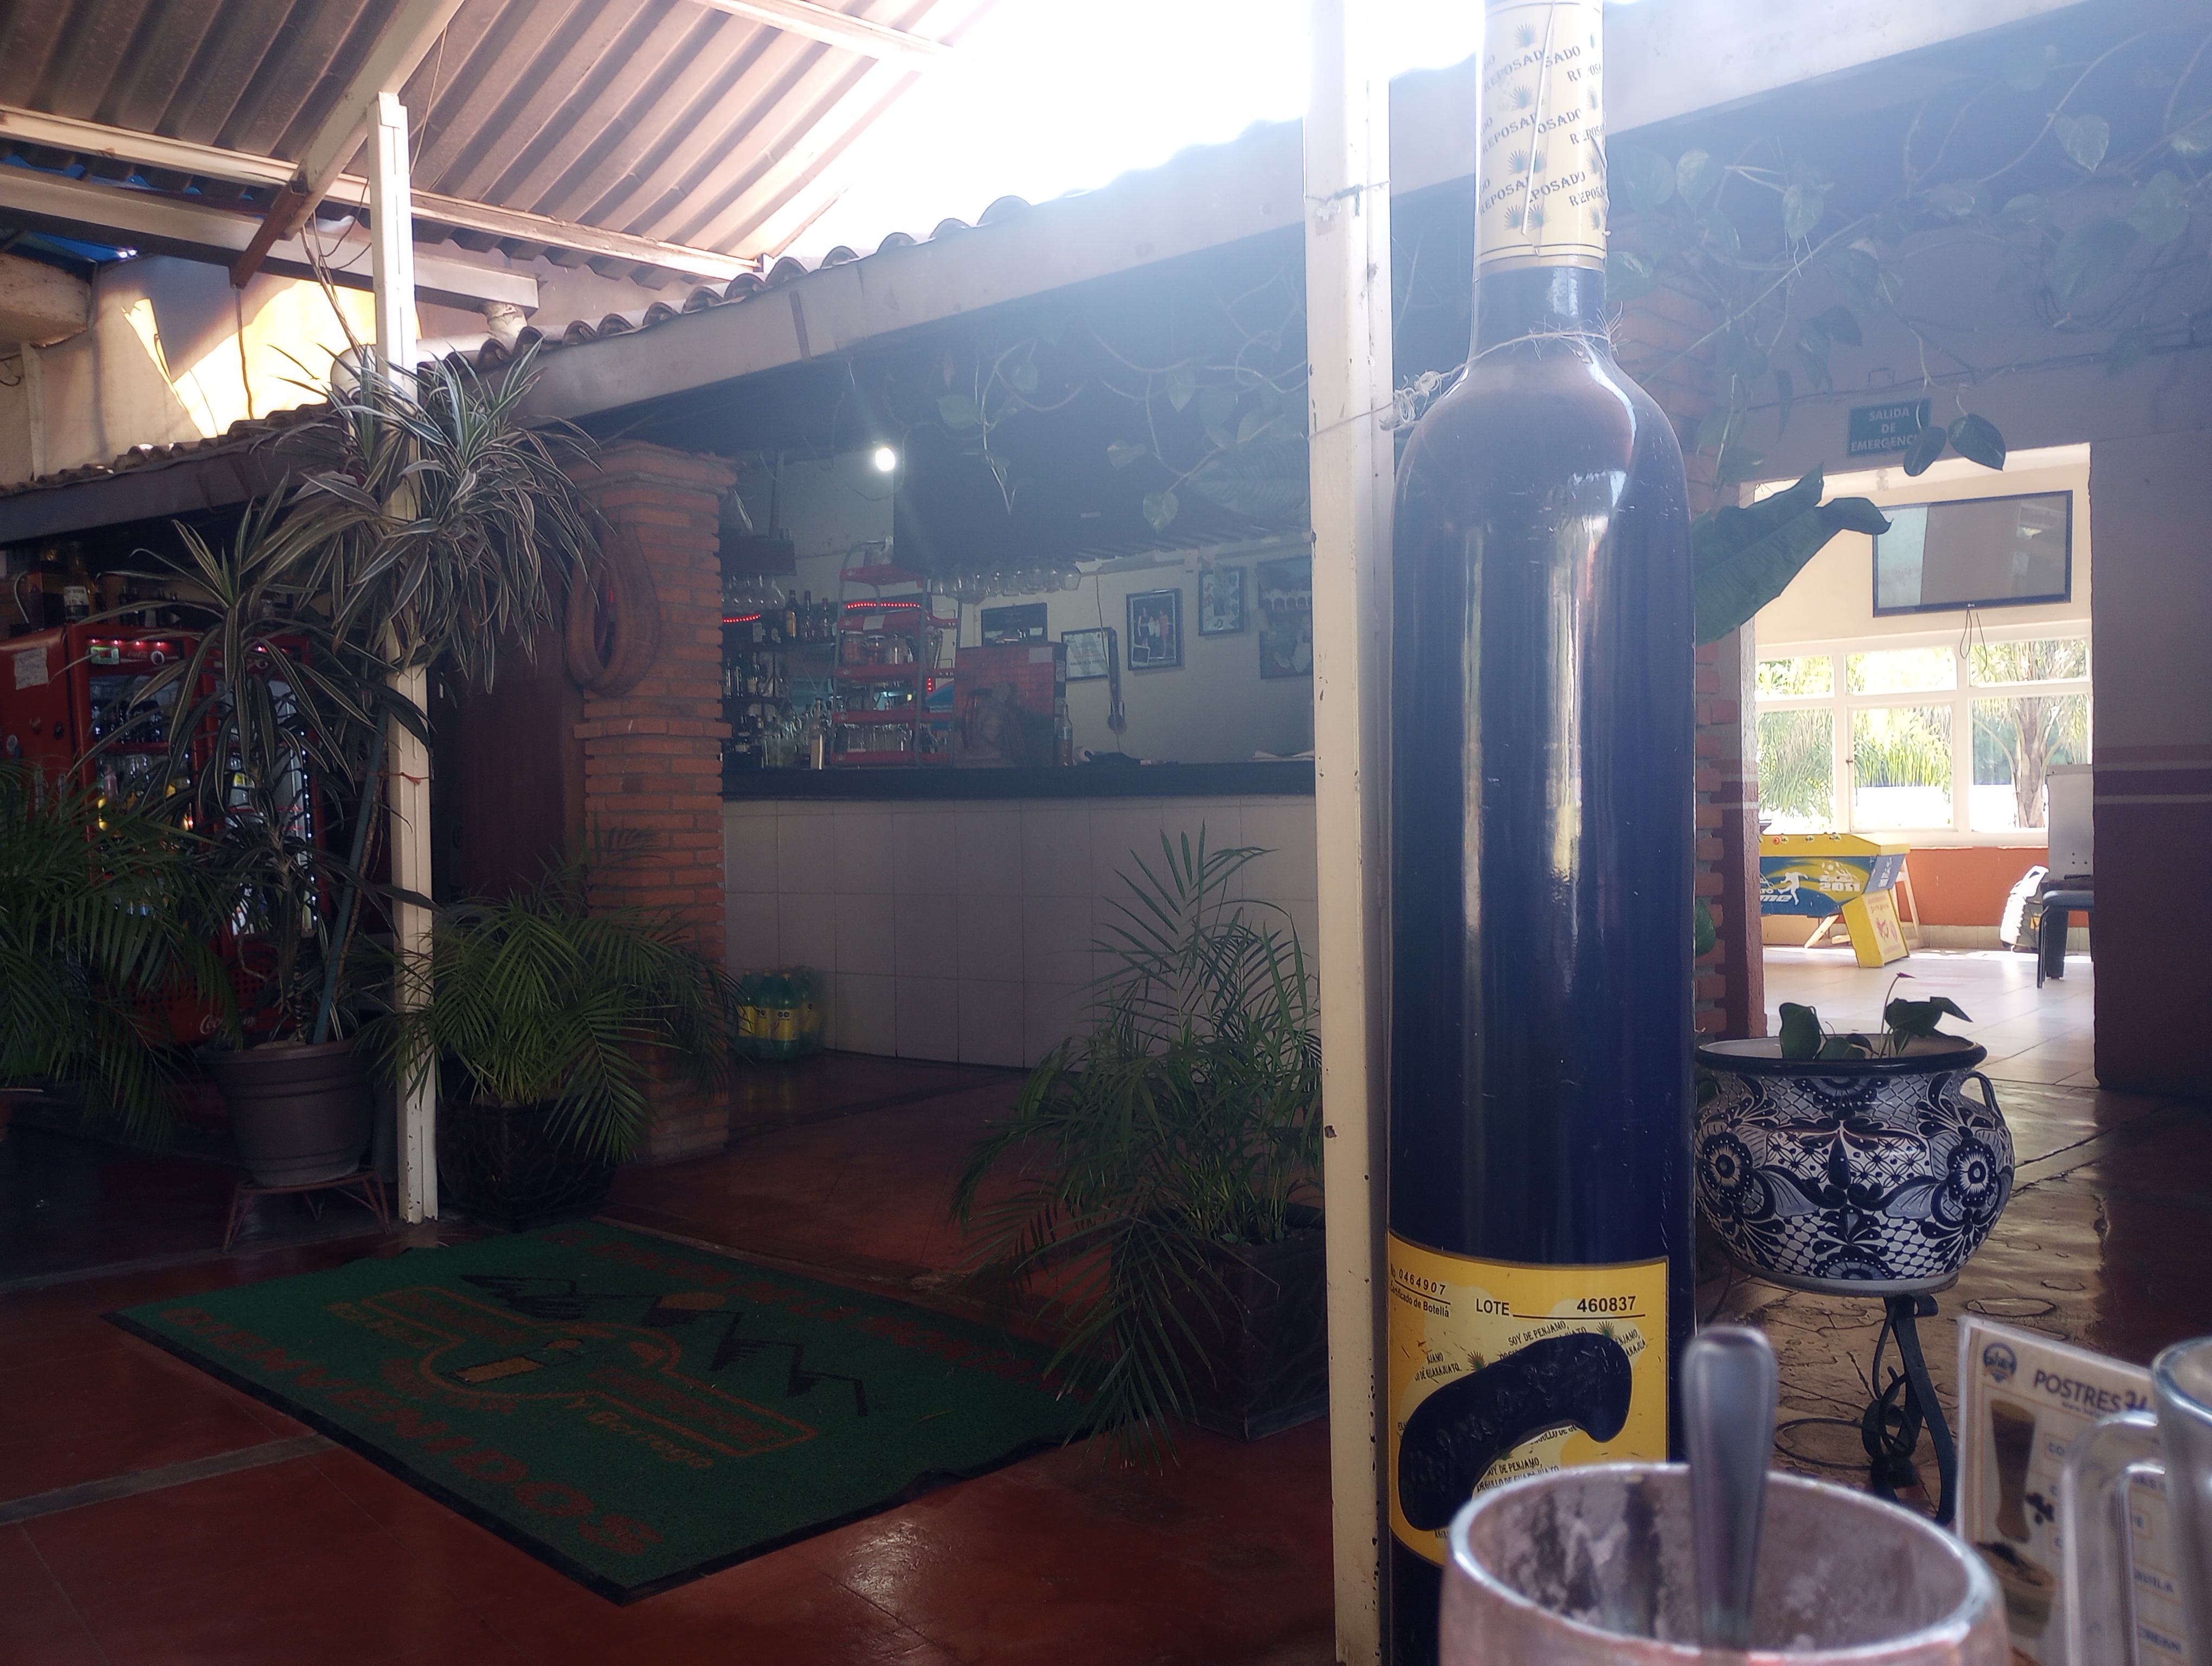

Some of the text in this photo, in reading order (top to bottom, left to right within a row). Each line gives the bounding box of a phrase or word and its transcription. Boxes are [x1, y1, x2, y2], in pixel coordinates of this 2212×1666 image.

[1484, 48, 1545, 92] REPOSAD
[1480, 177, 1529, 216] REPOSA
[1869, 407, 1909, 421] SALIDA
[1881, 423, 1896, 434] DE
[1851, 434, 1917, 451] EMERGENC
[1399, 1268, 1445, 1295] 0464907
[785, 1297, 859, 1322] LA
[1414, 1298, 1421, 1309] de
[1423, 1300, 1449, 1317] Botella
[1476, 1296, 1636, 1316] LOTE 460837
[1508, 1332, 1521, 1347] SOY
[1523, 1330, 1534, 1342] DE
[2034, 1369, 2122, 1413] POSTRES
[160, 1307, 663, 1555] BIENVENIDOS
[1499, 1464, 1508, 1475] DE
